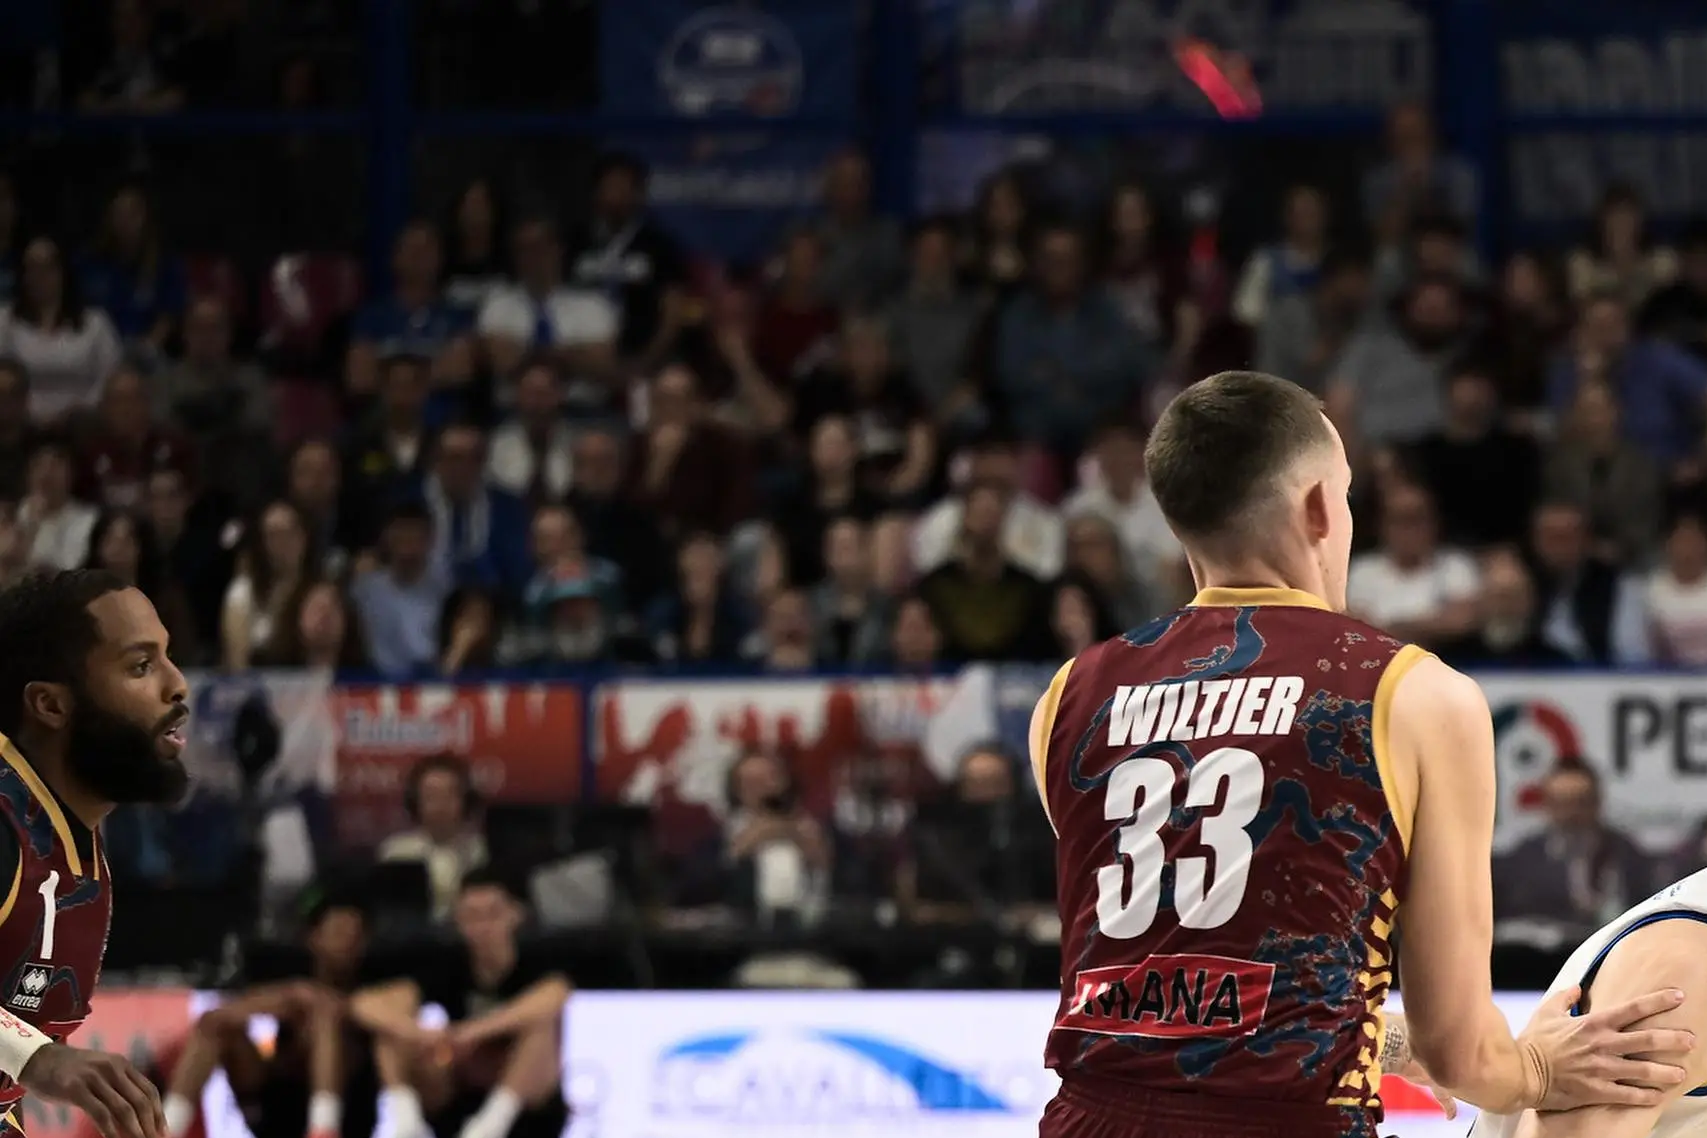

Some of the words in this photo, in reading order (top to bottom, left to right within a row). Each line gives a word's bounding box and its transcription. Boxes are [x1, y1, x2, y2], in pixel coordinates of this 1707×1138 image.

[1106, 676, 1305, 747] WILTJER
[1095, 747, 1266, 939] 33
[38, 870, 60, 960] 1
